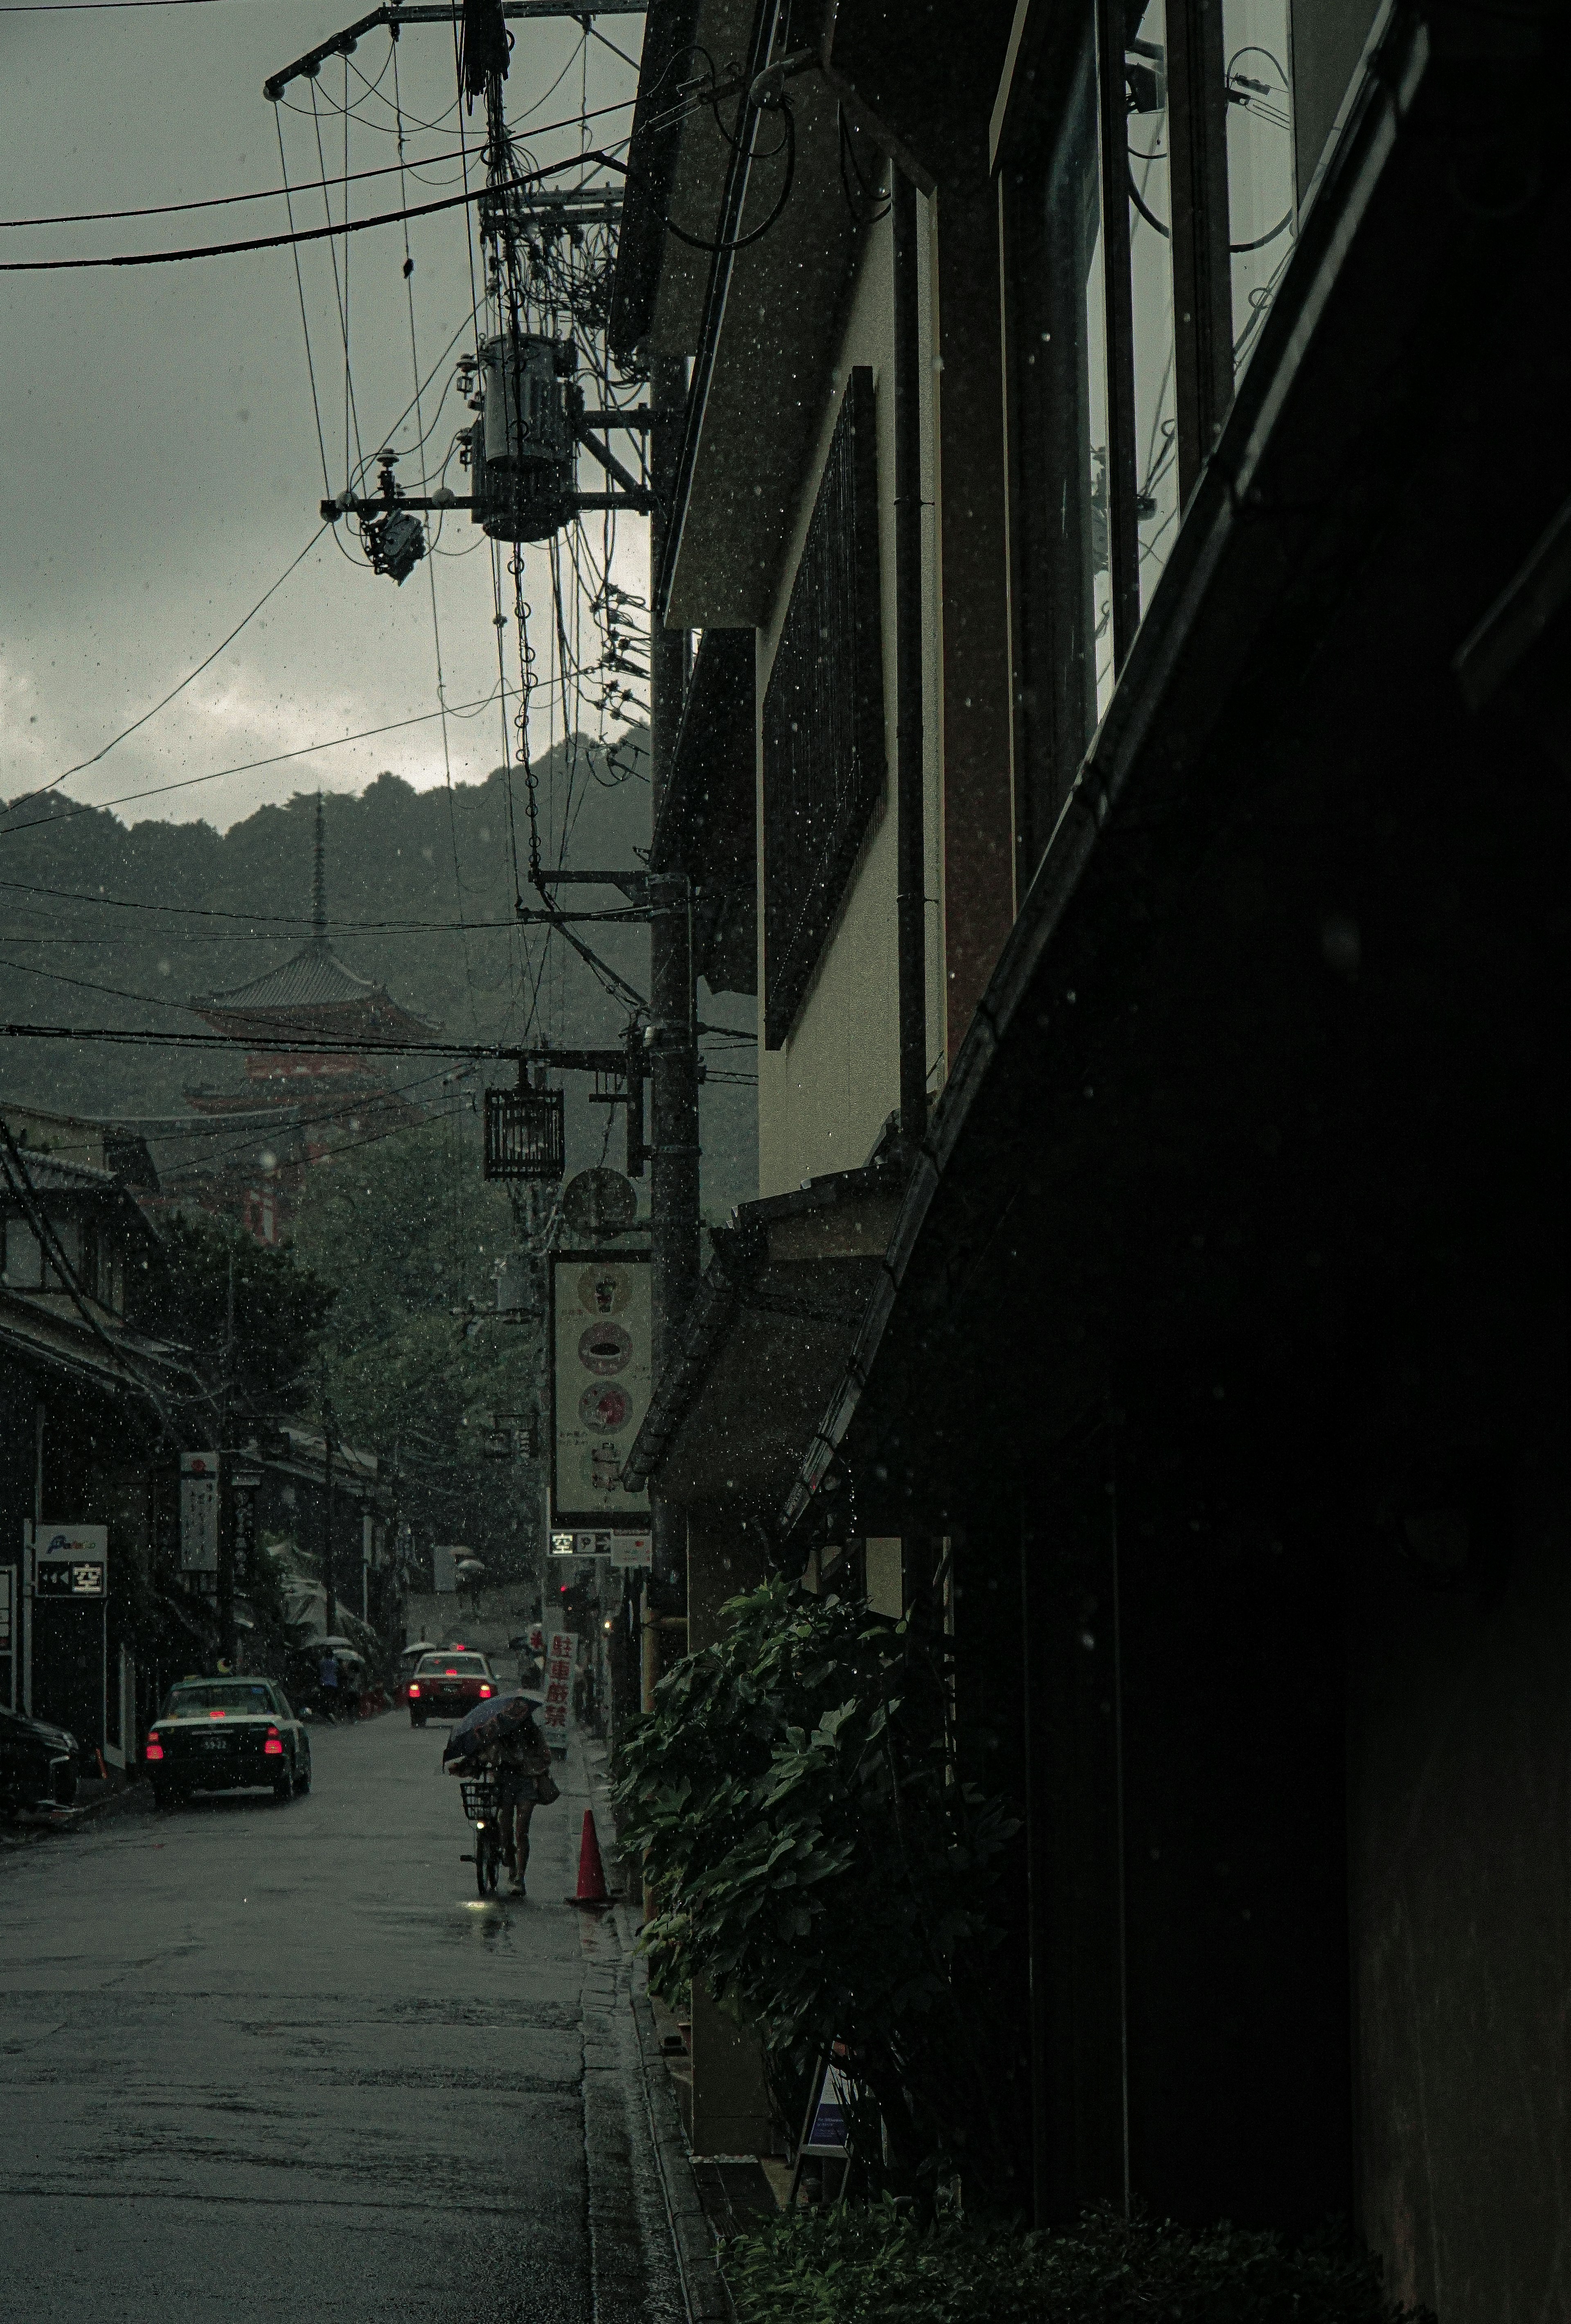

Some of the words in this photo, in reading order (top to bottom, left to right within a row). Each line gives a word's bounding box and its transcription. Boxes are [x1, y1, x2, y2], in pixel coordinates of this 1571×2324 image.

[552, 1533, 573, 1554] 空
[74, 1564, 101, 1592] 空
[545, 1636, 572, 1727] 駐車厳禁
